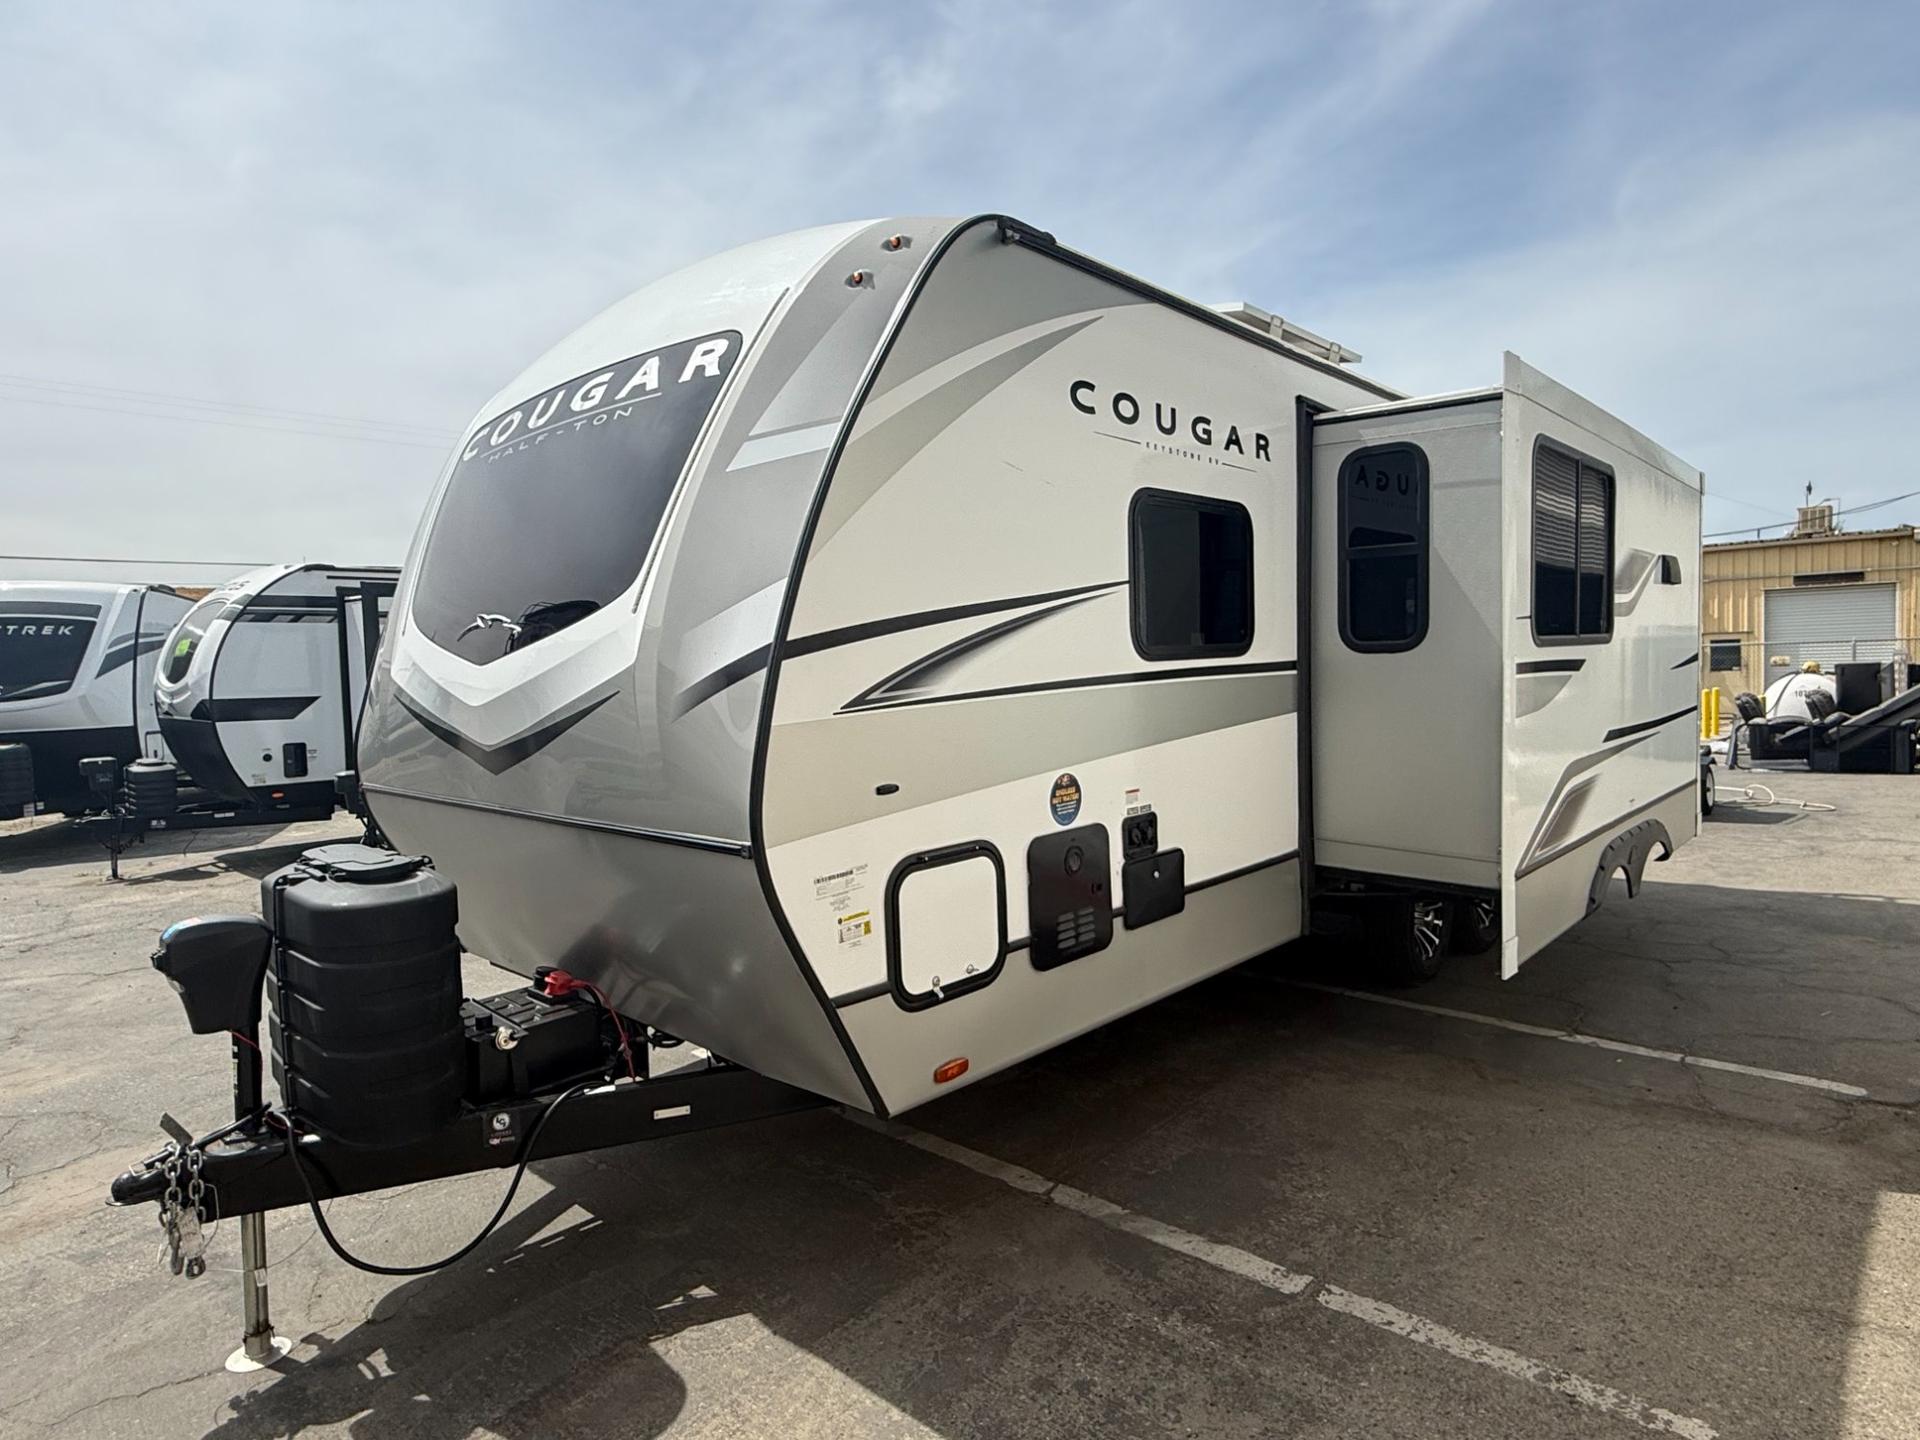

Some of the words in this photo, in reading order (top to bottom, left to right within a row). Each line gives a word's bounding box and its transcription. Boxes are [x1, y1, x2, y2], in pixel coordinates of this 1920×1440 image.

[463, 338, 729, 461] COUGAR
[1070, 380, 1271, 462] COUGAR
[488, 407, 633, 463] HALF-TON
[0, 625, 75, 635] TREK
